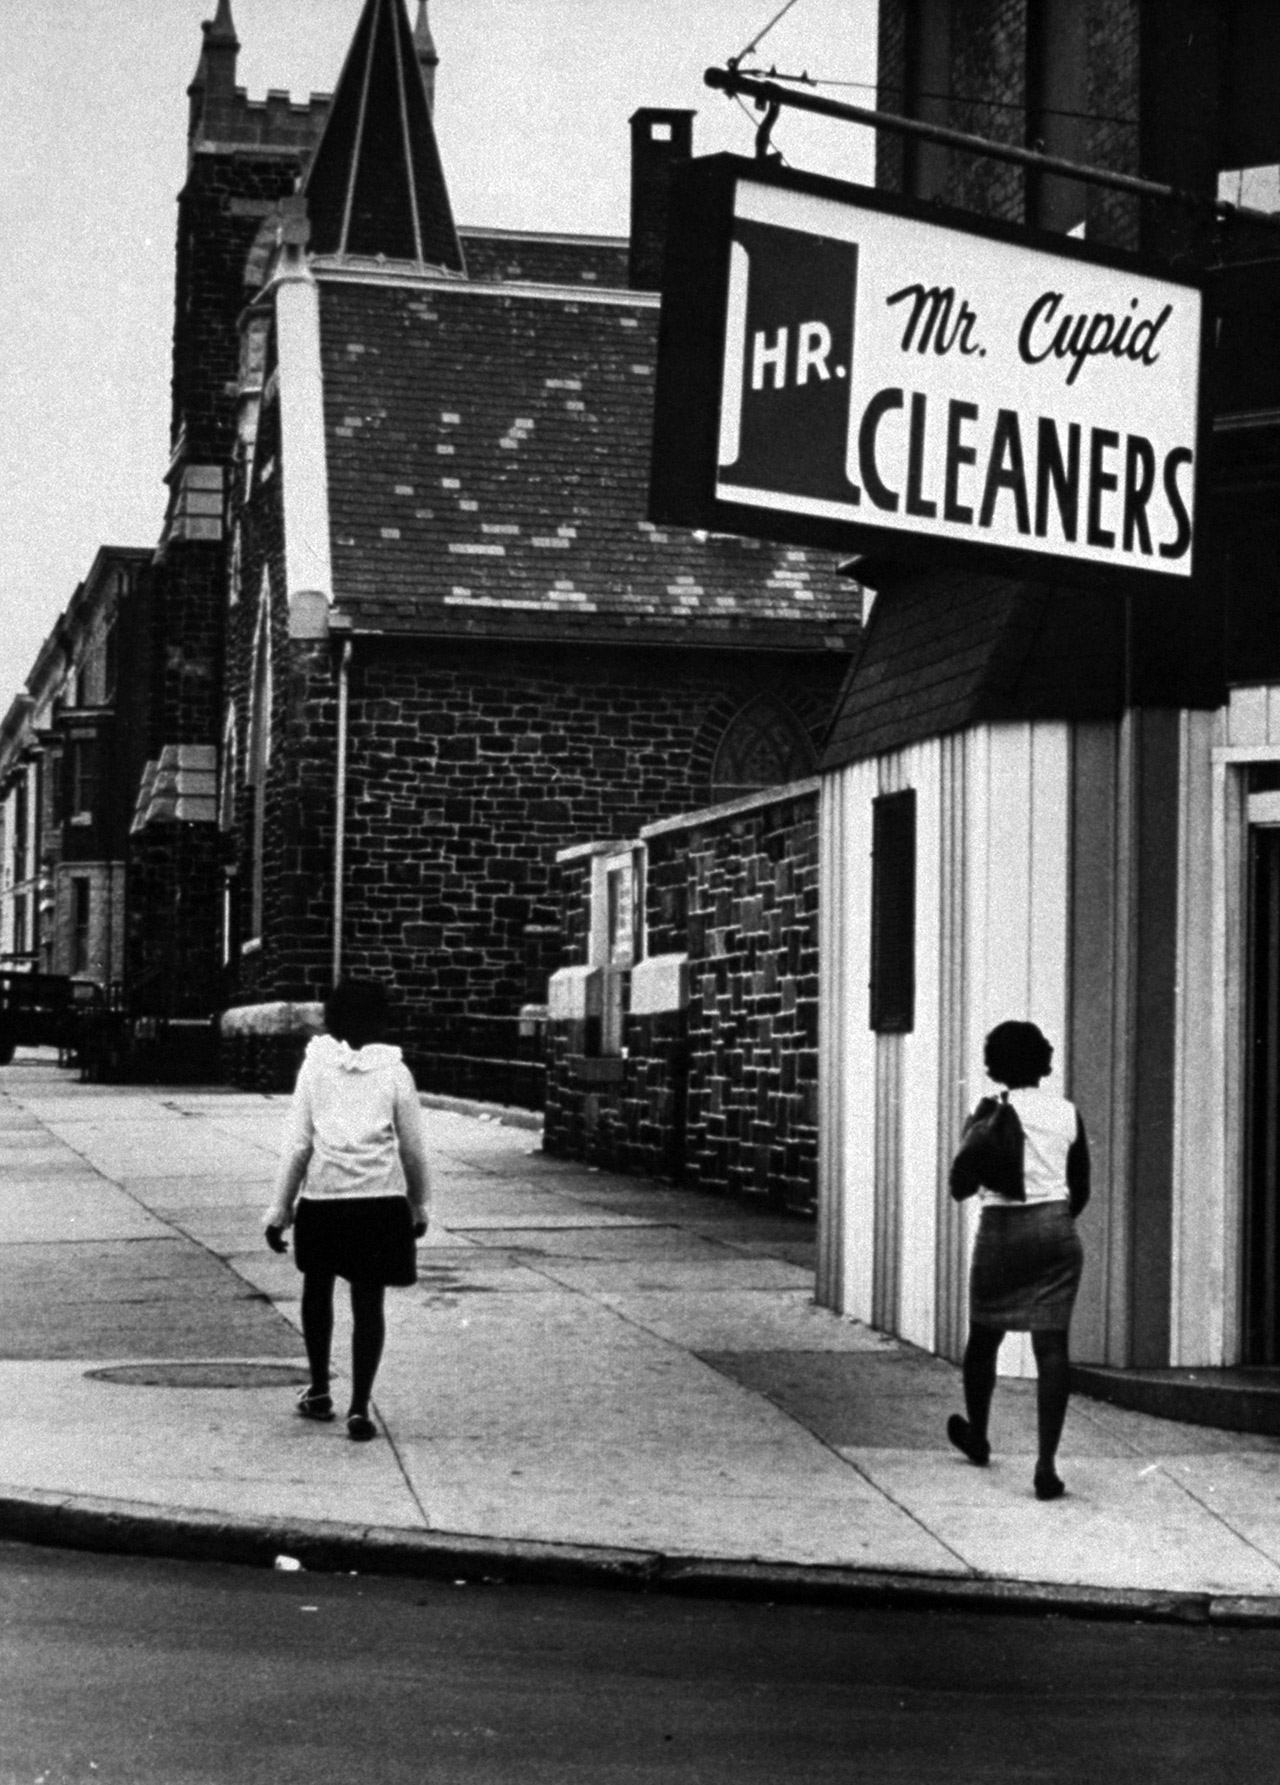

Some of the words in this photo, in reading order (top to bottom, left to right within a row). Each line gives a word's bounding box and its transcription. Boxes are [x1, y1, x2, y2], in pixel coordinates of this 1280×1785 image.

[717, 217, 861, 506] 1
[751, 320, 847, 391] HR.
[886, 283, 988, 358] Mr.
[1018, 291, 1173, 386] Cupid
[858, 387, 1193, 560] CLEANERS
